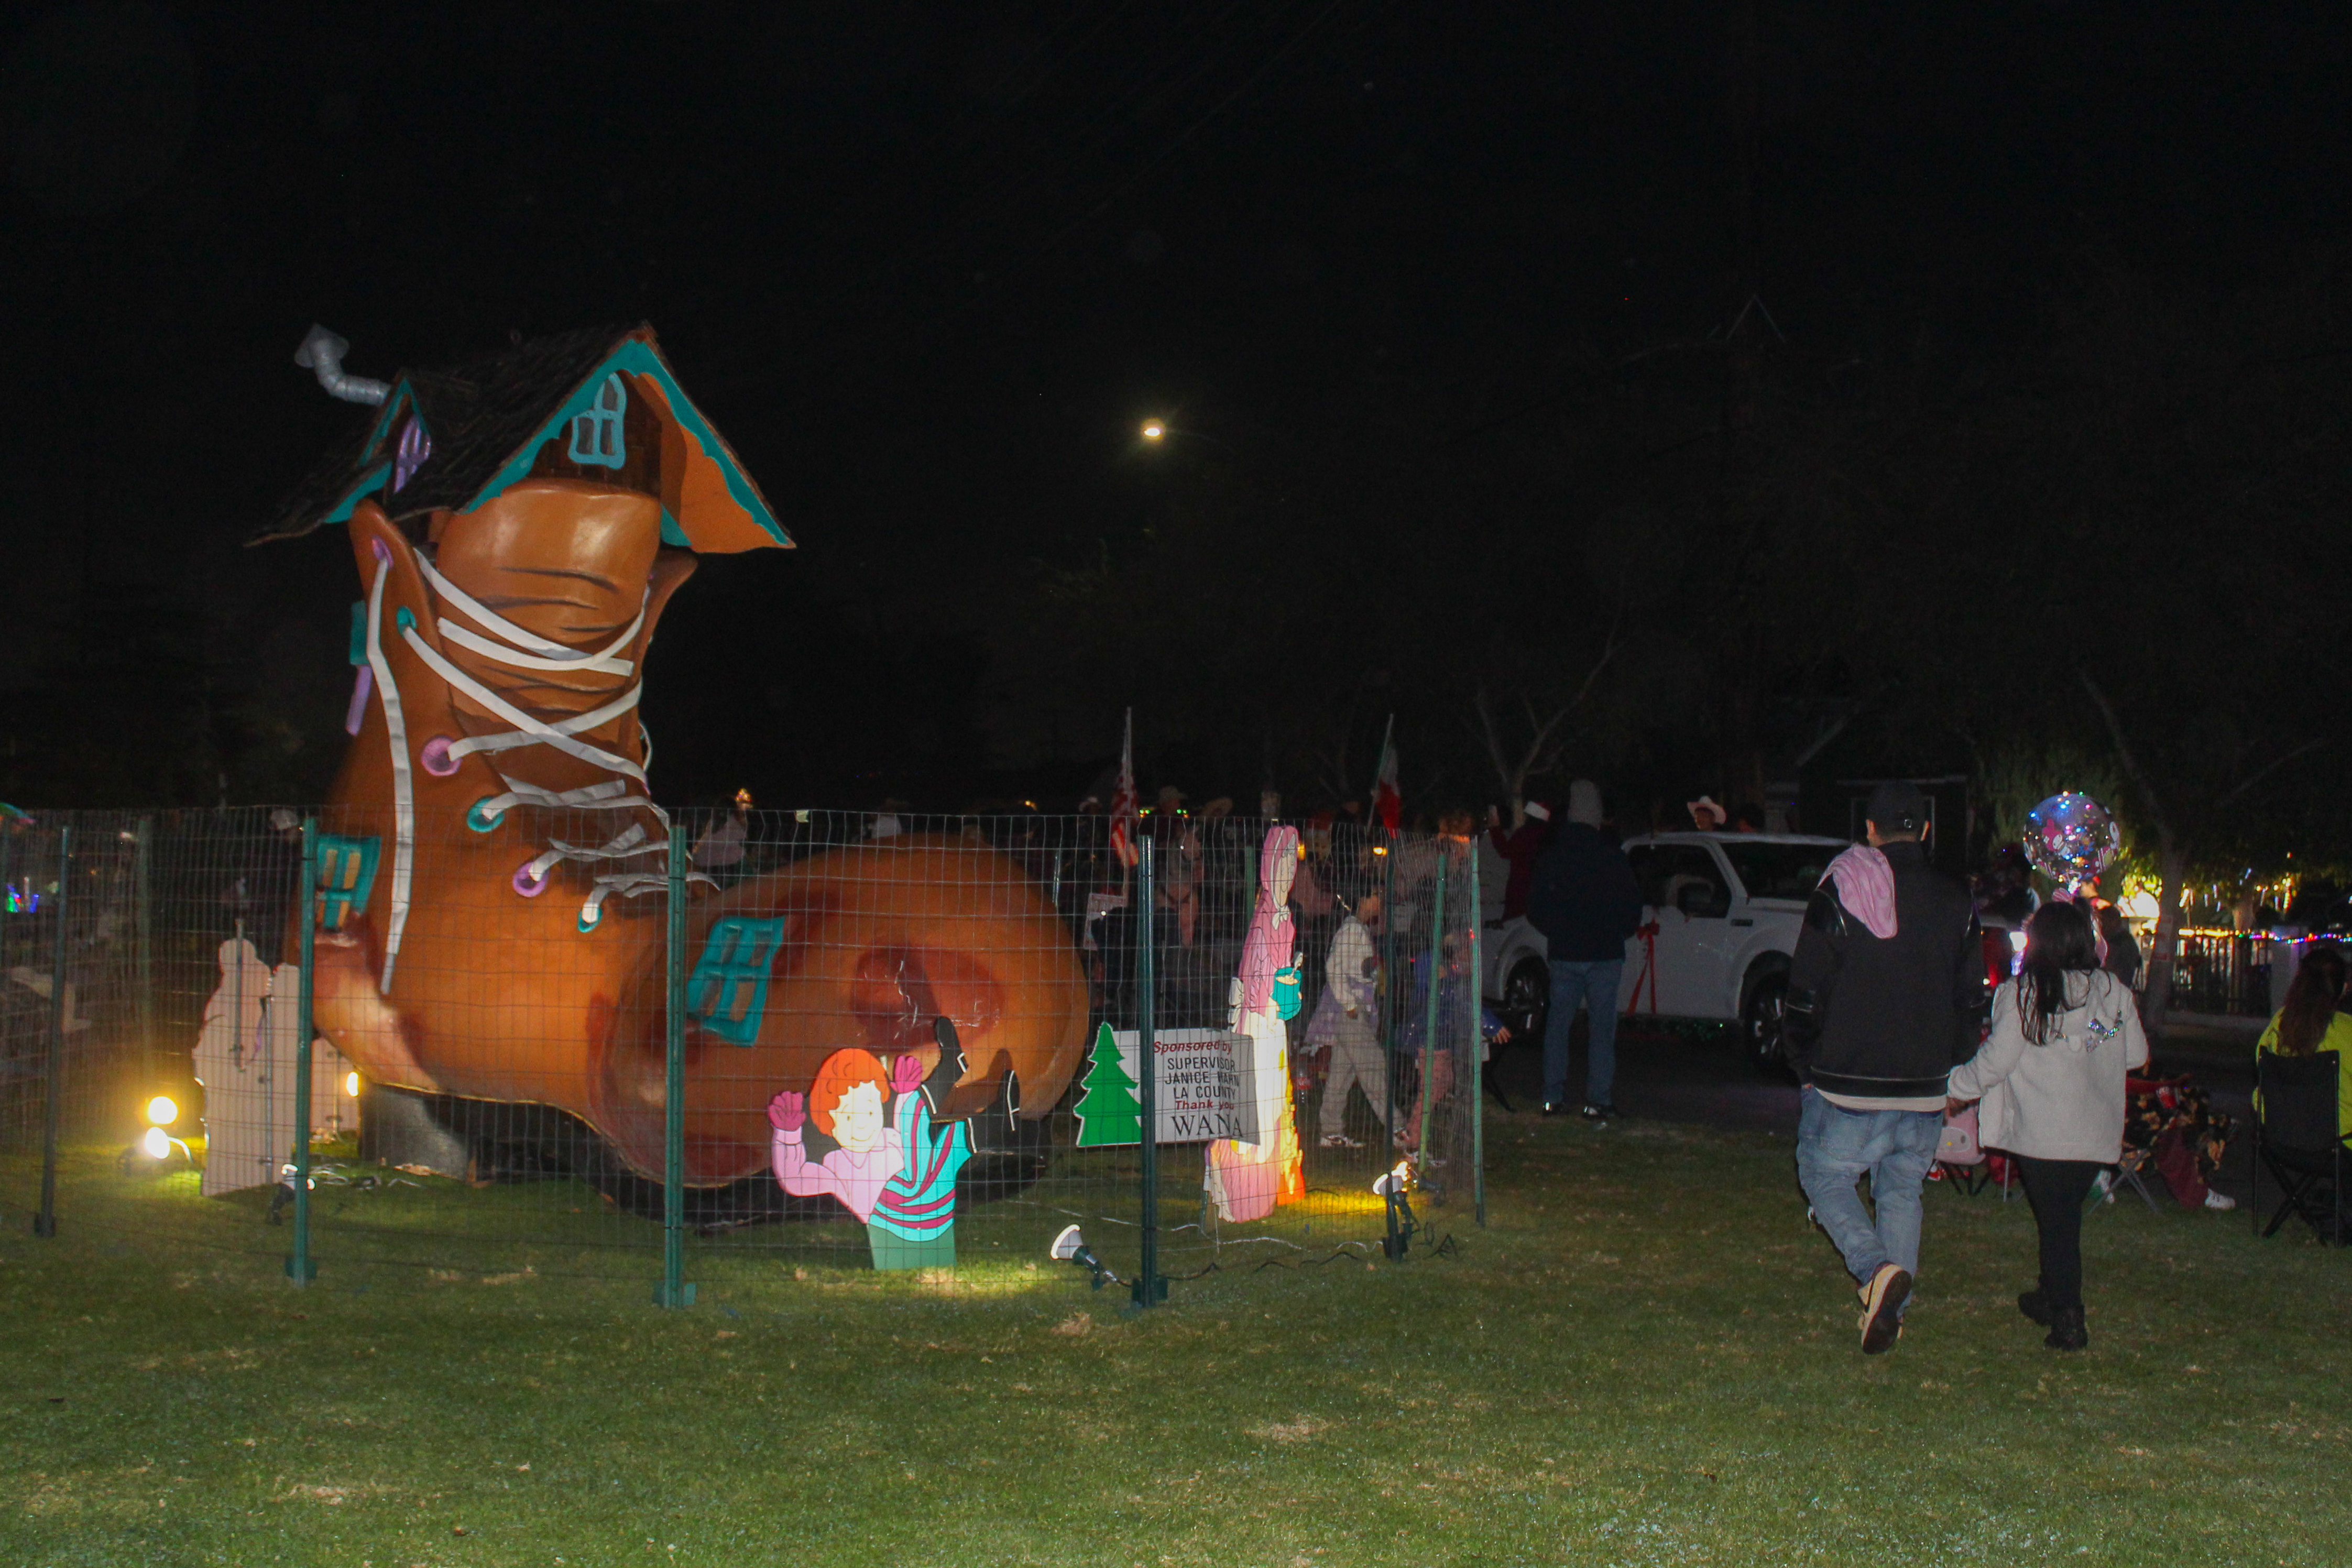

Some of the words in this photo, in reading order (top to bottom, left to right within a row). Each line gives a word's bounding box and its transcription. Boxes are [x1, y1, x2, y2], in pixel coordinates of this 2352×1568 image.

[1154, 1040, 1221, 1055] Sponsored
[1222, 1043, 1231, 1055] by
[1167, 1056, 1236, 1072] SUPERVISOR
[1165, 1071, 1210, 1084] JANICE
[1218, 1071, 1240, 1087] HAHN
[1173, 1087, 1188, 1099] LA
[1196, 1086, 1235, 1100] COUNTY
[1175, 1099, 1213, 1110] Thank
[1218, 1101, 1234, 1111] you
[1170, 1114, 1243, 1137] WANA
